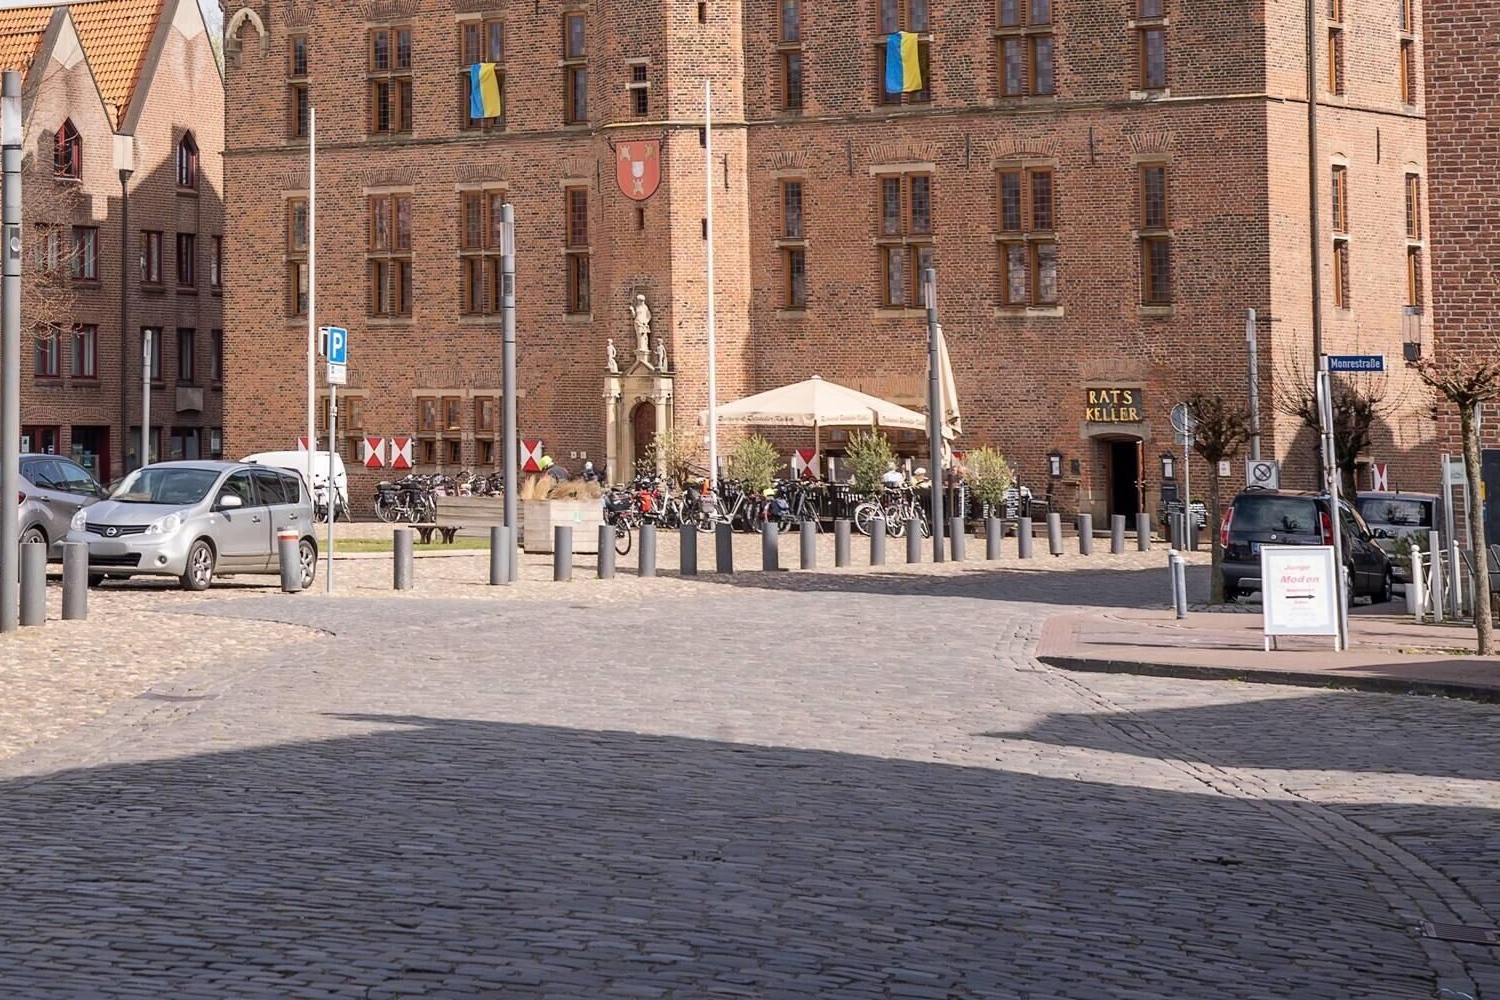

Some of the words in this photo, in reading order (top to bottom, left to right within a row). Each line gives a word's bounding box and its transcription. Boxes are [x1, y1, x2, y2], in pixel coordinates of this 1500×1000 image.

[333, 332, 343, 359] P
[1331, 358, 1380, 369] Monrestraße
[1089, 390, 1133, 405] RATS
[1086, 407, 1139, 422] KELLER
